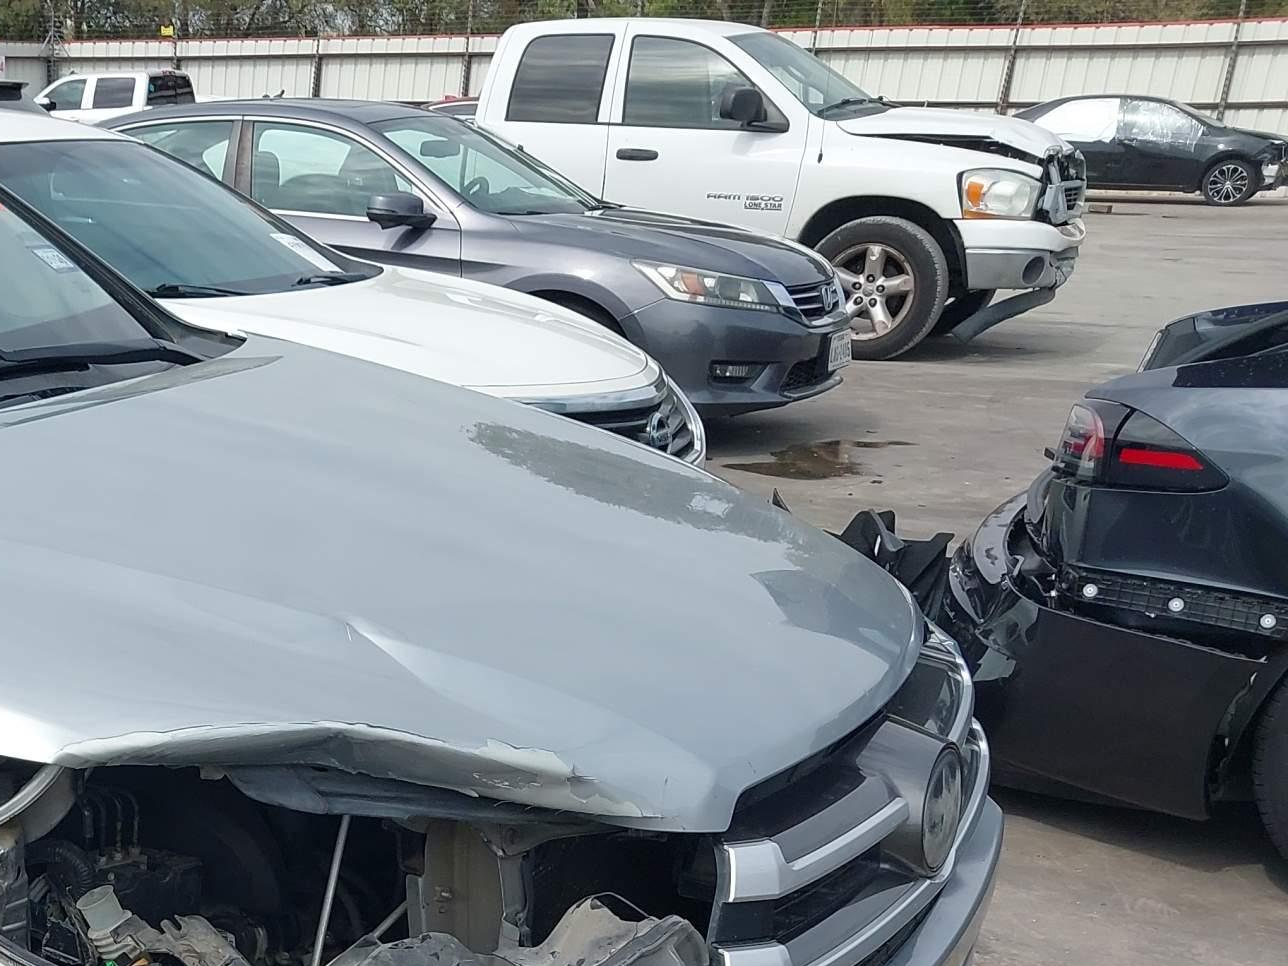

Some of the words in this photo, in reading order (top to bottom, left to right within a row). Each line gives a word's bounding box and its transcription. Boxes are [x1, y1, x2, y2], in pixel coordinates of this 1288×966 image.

[706, 192, 741, 201] RAM
[745, 194, 784, 202] 1500
[744, 201, 762, 209] LONE
[764, 202, 782, 210] STAR
